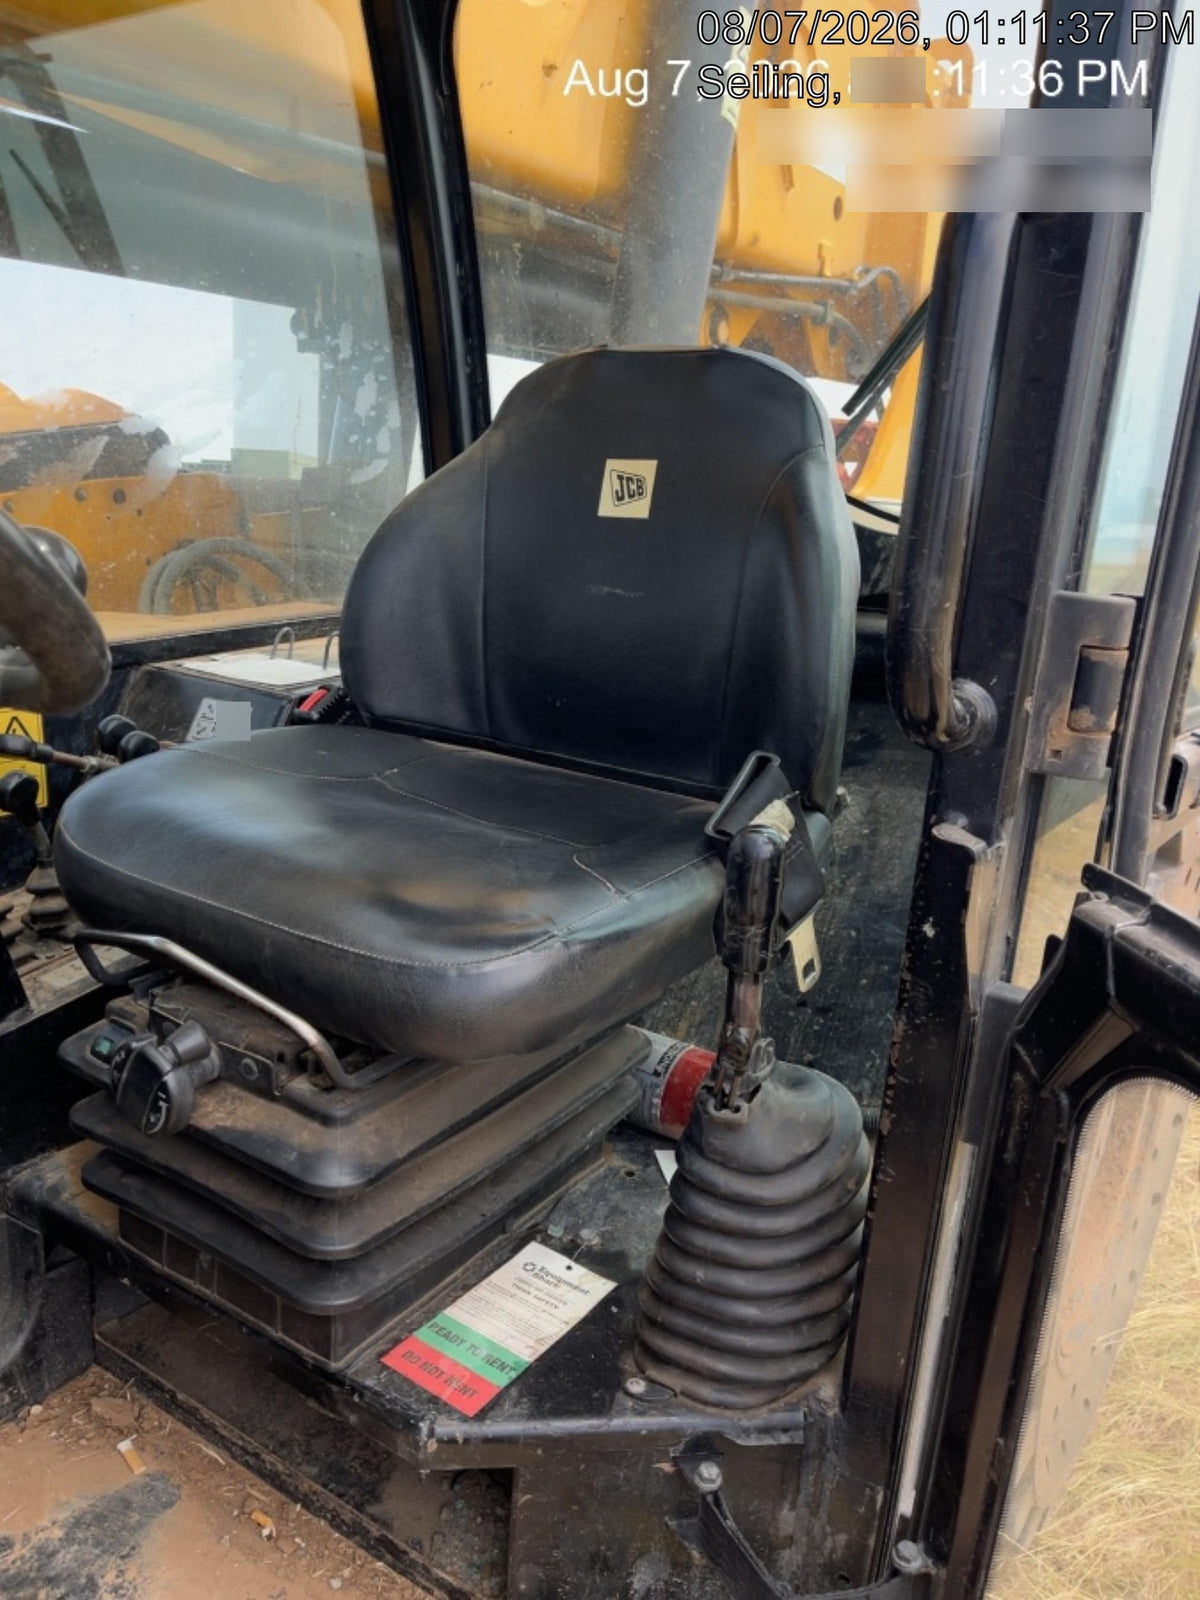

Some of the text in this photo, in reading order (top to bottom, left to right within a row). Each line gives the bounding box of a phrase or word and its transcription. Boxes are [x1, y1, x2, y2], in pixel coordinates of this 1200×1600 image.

[615, 474, 645, 502] JCB
[427, 1321, 515, 1376] READY TO RENT
[401, 1349, 423, 1365] DO
[418, 1360, 447, 1380] NOT
